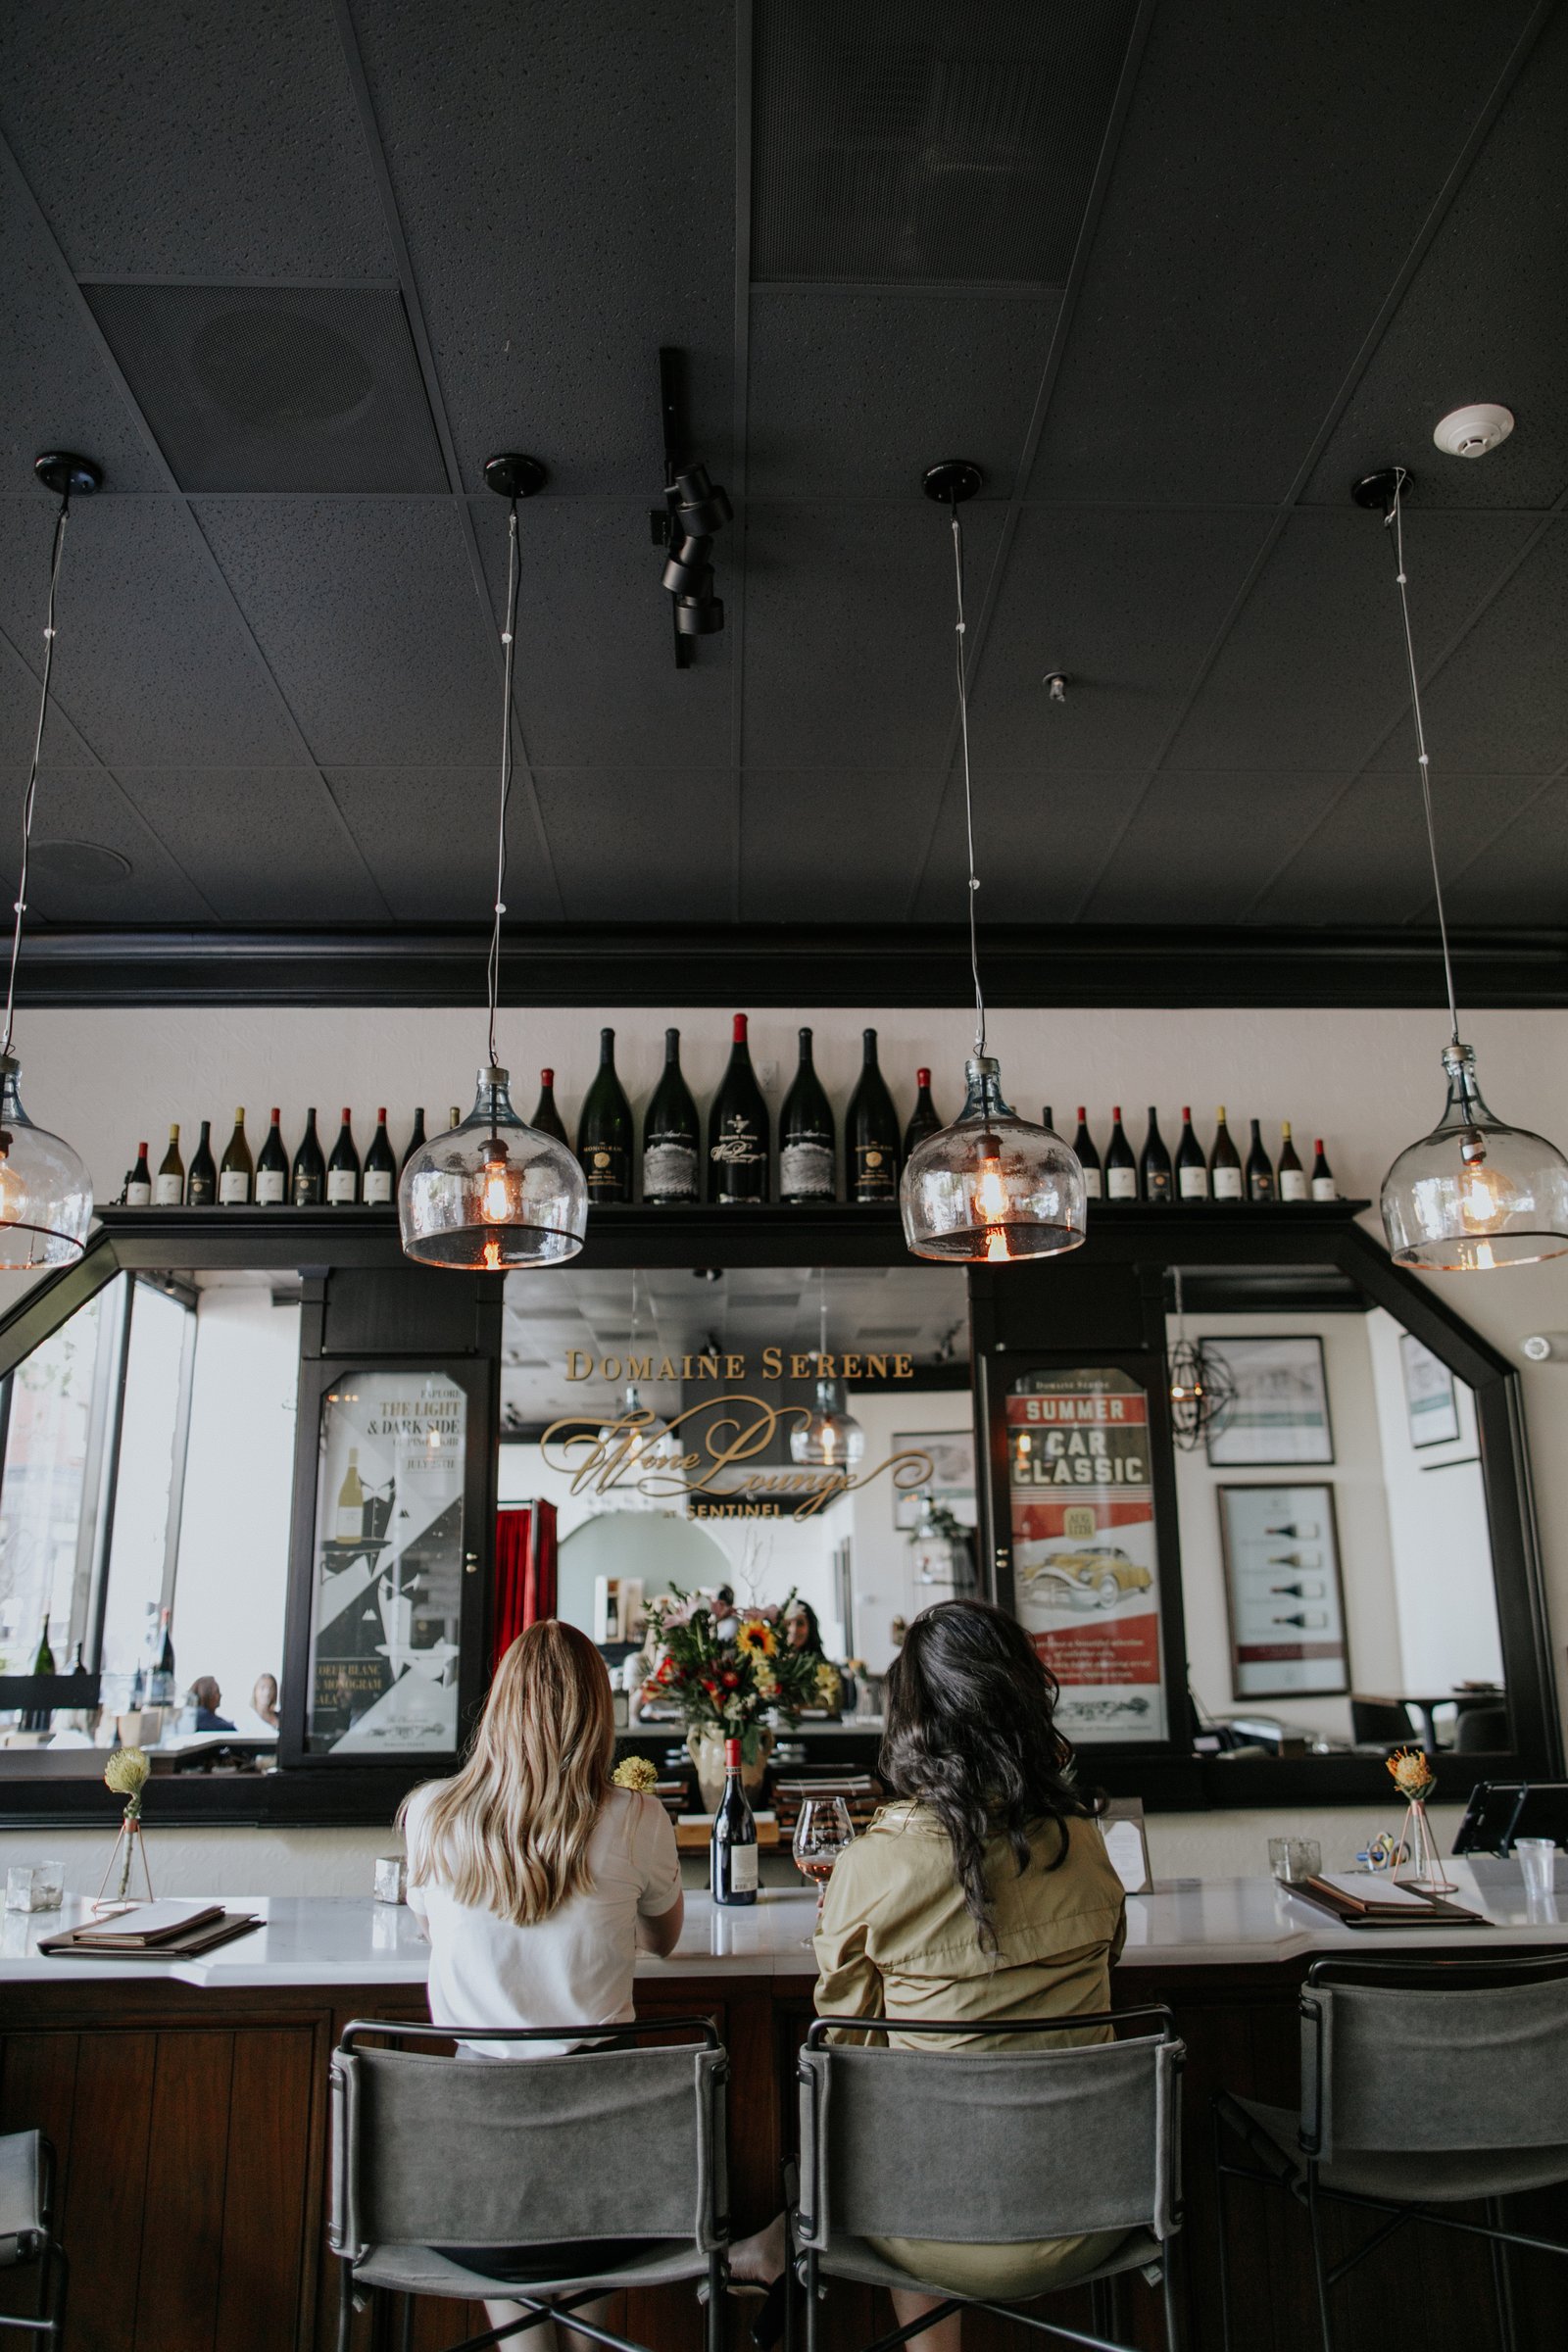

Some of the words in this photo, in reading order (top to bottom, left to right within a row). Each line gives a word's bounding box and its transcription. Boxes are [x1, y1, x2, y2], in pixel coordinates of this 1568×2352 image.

[565, 1349, 746, 1382] DOMAINE
[761, 1348, 913, 1380] SERENE
[379, 1401, 411, 1416] THE
[415, 1401, 461, 1416] LIGHT
[1026, 1398, 1124, 1420] SUMMER
[368, 1420, 377, 1435] &
[382, 1420, 421, 1435] DARK
[426, 1419, 460, 1434] SIDE
[1047, 1431, 1106, 1456] CAR
[540, 1407, 702, 1496] Wine
[637, 1395, 935, 1522] Lounge
[1013, 1456, 1143, 1484] CLASSIC
[686, 1503, 784, 1521] SENTINEL
[323, 1678, 381, 1690] MONOGRAM
